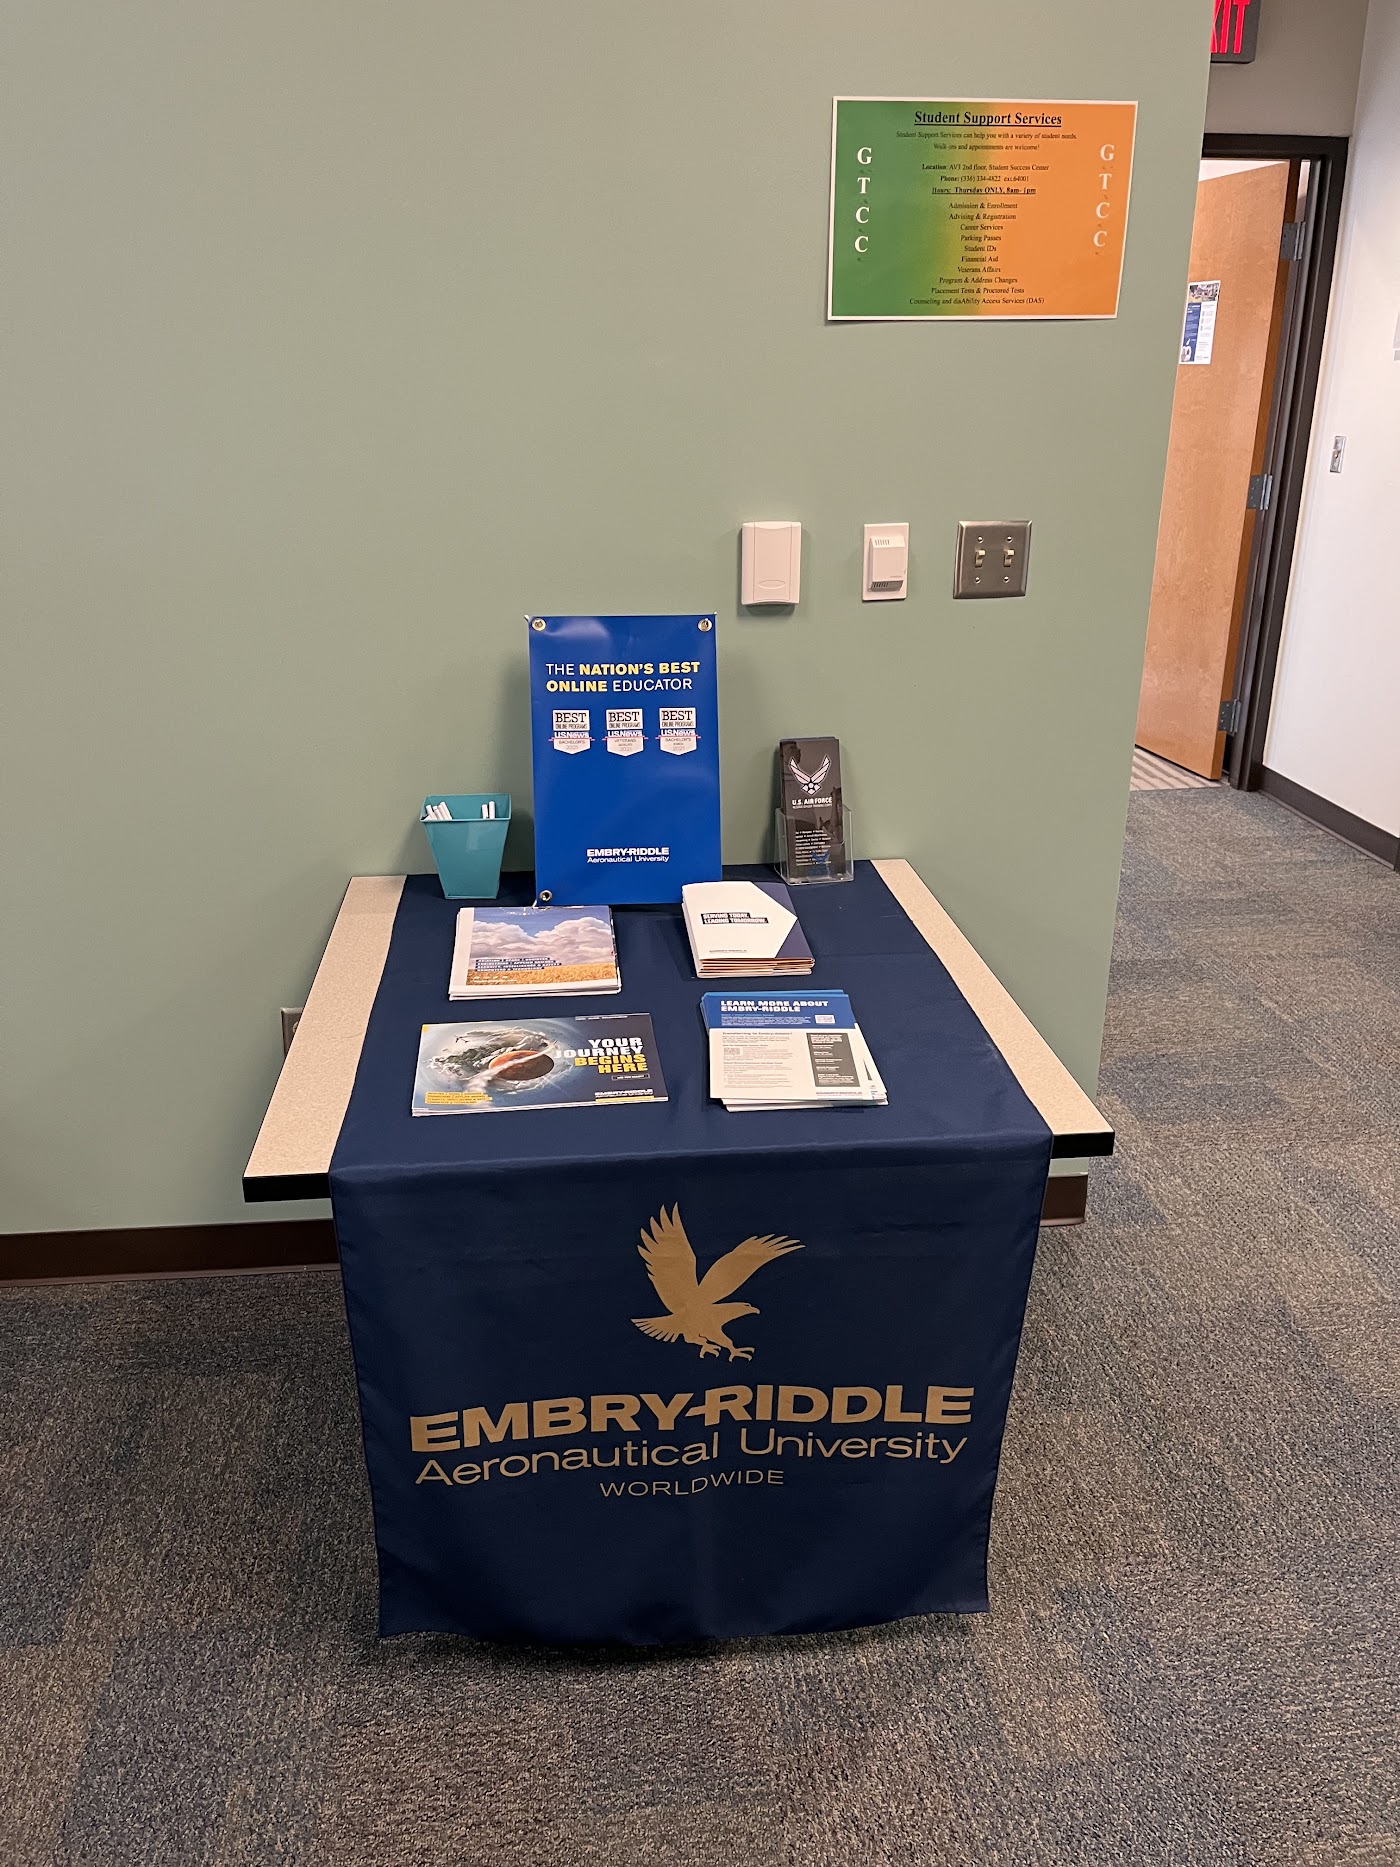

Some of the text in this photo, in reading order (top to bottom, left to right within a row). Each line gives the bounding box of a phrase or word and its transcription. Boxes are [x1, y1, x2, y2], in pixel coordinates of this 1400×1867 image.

[914, 111, 1062, 126] Student Support Services
[918, 131, 939, 139] Support
[974, 132, 985, 140] help
[1015, 132, 1033, 140] variety
[910, 298, 941, 306] Counseling
[546, 662, 700, 675] THE NATION'S BEST
[546, 678, 692, 692] ONLINE EDUCATOR
[555, 712, 586, 722] BEST
[608, 712, 639, 722] BEST
[662, 711, 693, 720] BEST
[587, 847, 669, 857] EMBRY-RIDDLE
[634, 855, 669, 863] University
[588, 1037, 642, 1048] YOUR
[554, 1046, 643, 1058] JOURNEY
[574, 1054, 646, 1066] BEGINS
[598, 1062, 648, 1074] HERE
[410, 1385, 974, 1452] EMBRY-RIDDLE
[415, 1428, 968, 1486] Aeronautical University
[600, 1469, 784, 1497] WORLDWIDE
